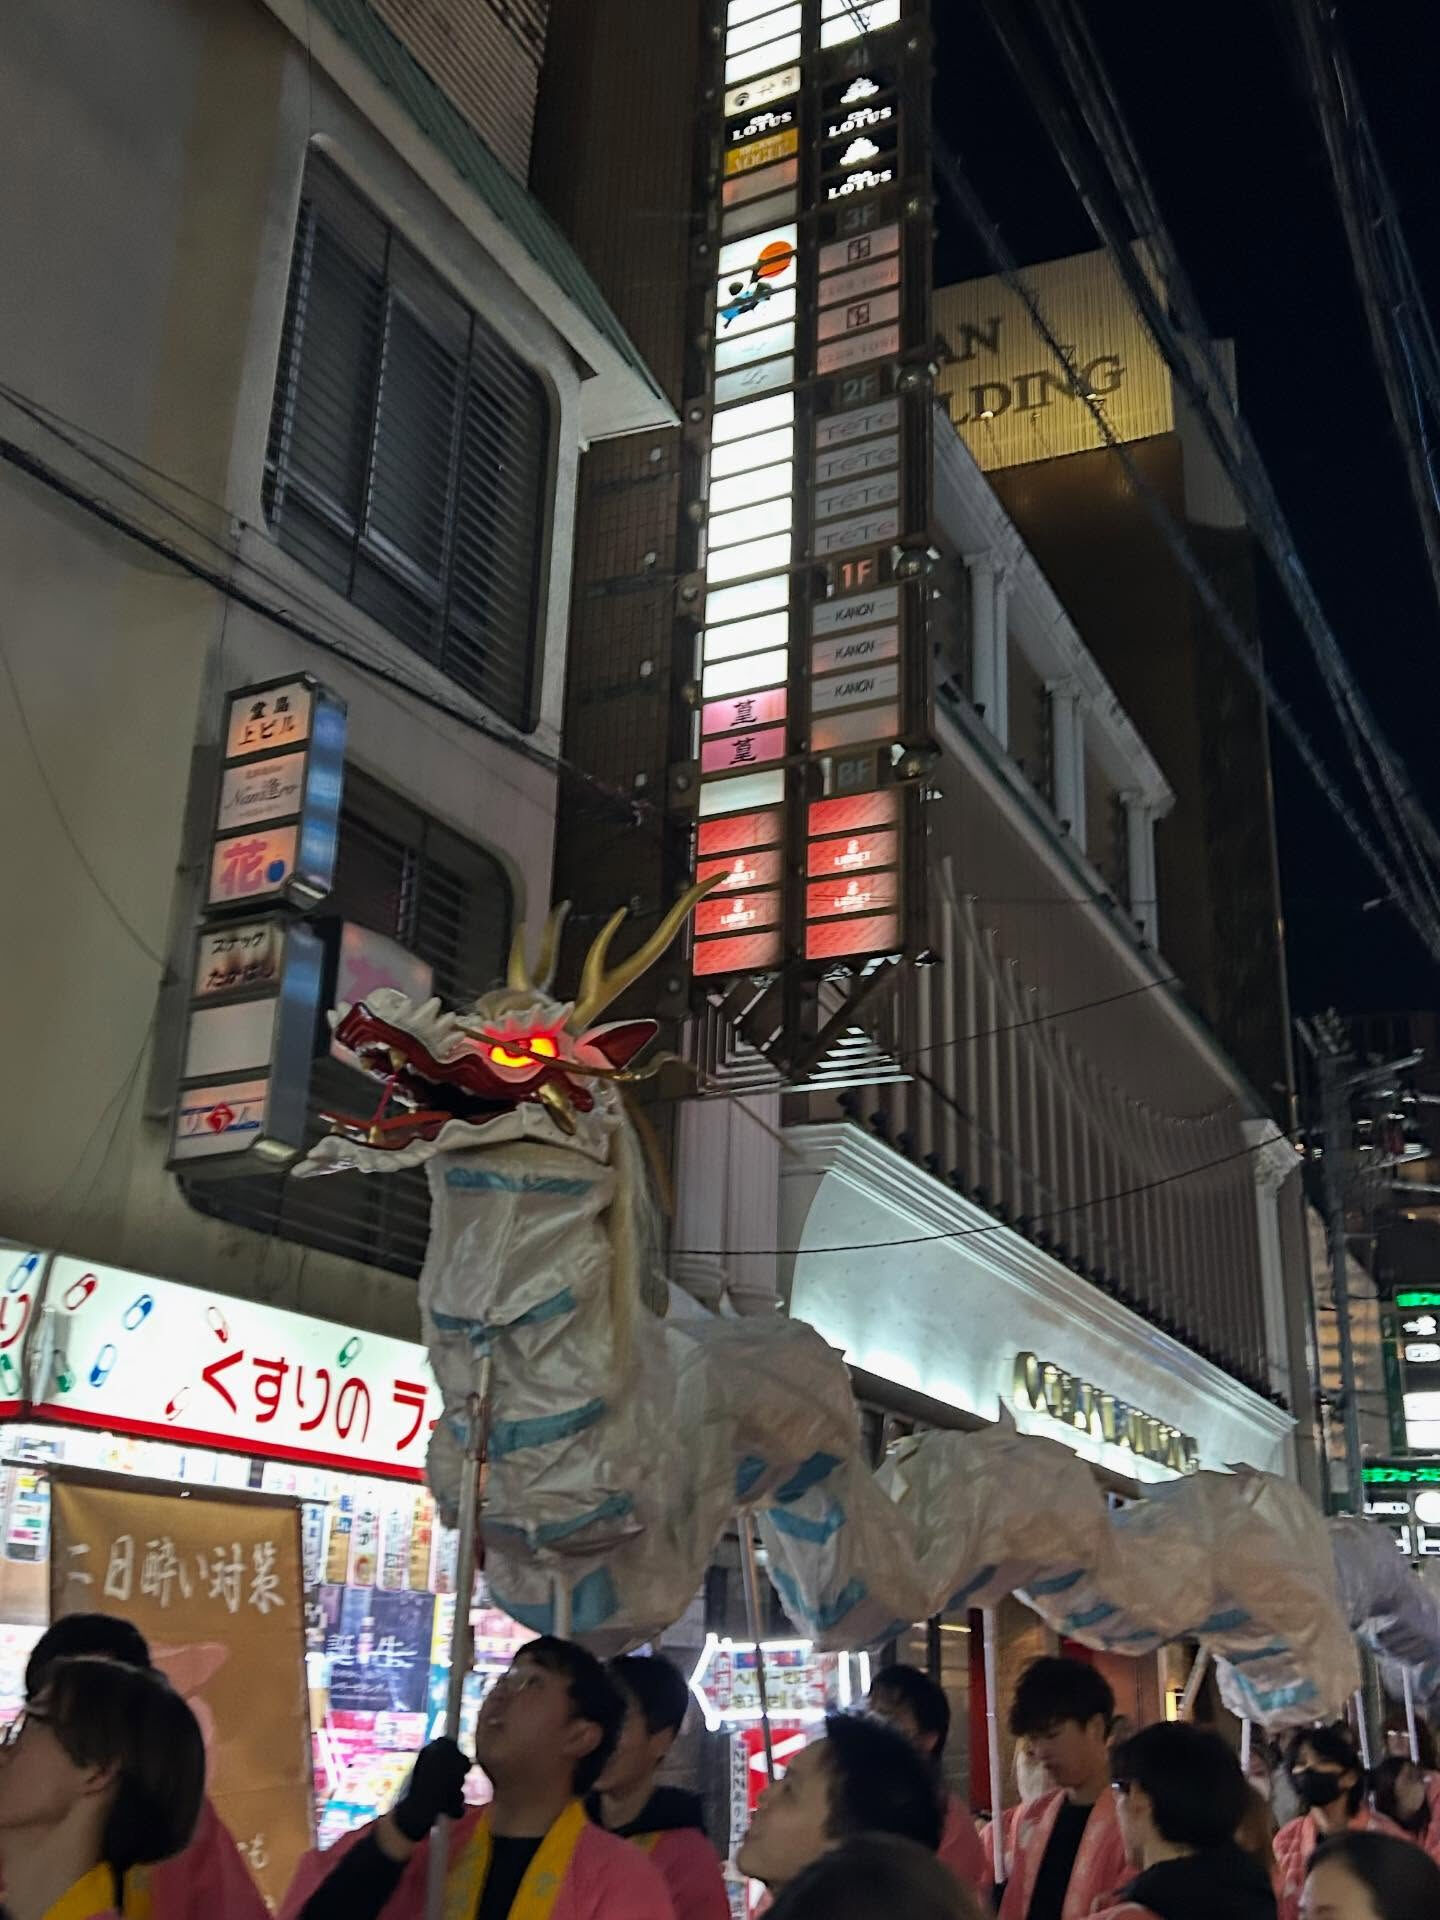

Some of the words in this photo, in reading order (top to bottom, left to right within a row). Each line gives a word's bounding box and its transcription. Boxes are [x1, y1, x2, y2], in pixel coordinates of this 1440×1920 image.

[732, 112, 792, 141] LOTUS
[828, 107, 892, 138] LOTUS
[828, 170, 892, 200] LOTUS
[845, 204, 876, 231] 3F
[843, 379, 876, 402] 2F
[841, 559, 873, 588] 1F
[220, 838, 267, 896] 花
[202, 1349, 437, 1451] くすりのラ
